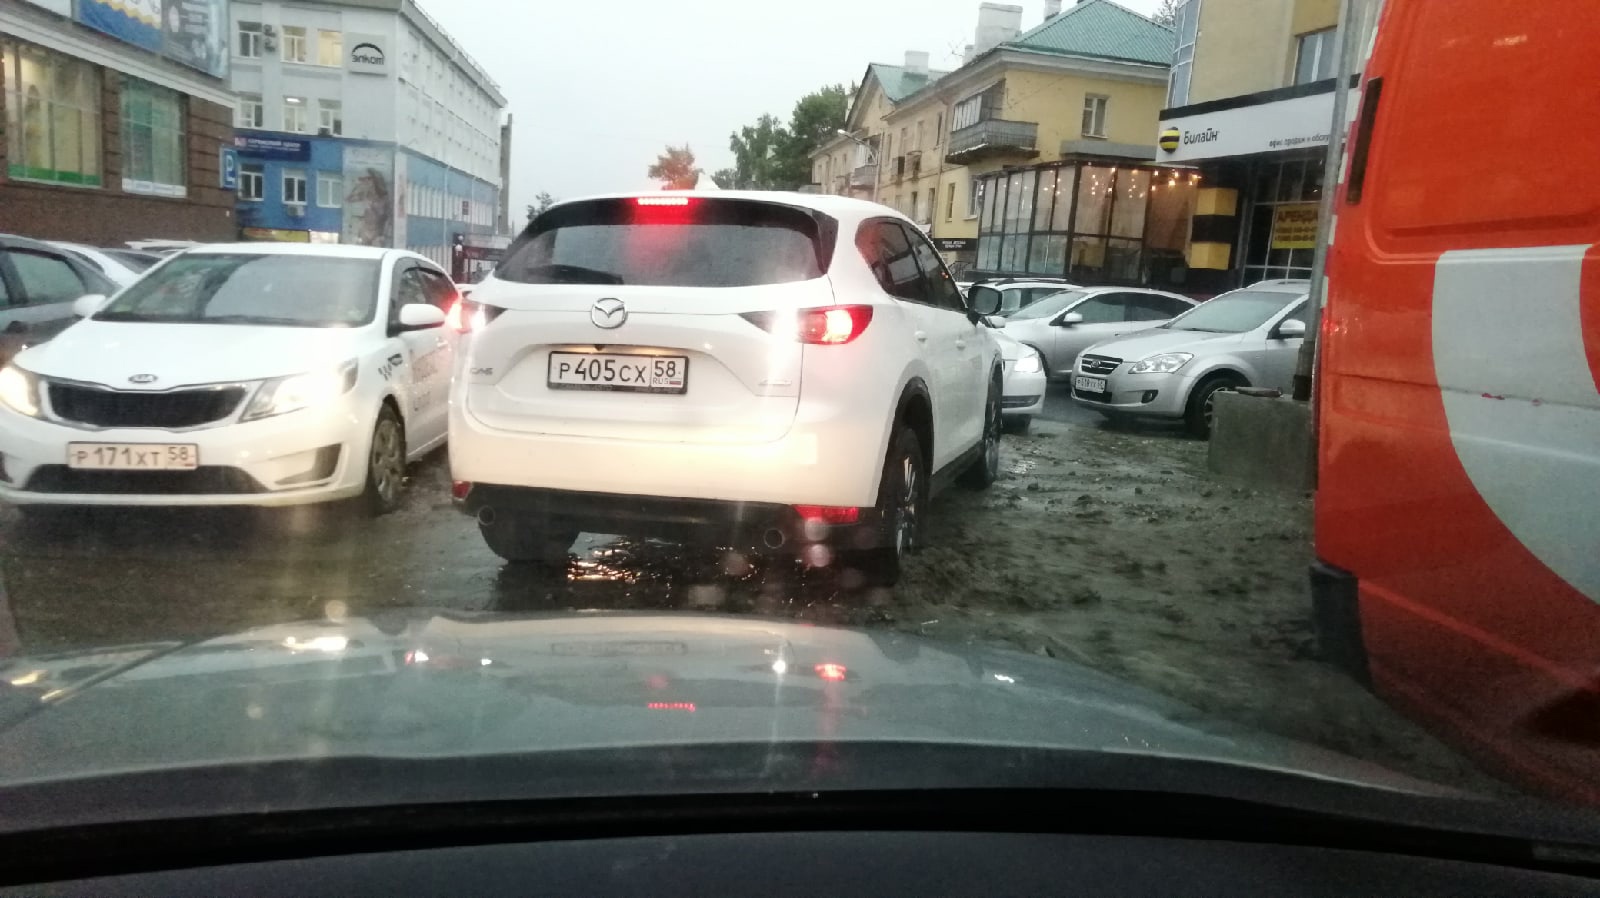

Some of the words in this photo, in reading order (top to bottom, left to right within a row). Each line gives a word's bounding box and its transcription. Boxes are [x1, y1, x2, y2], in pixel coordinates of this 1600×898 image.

[1183, 127, 1219, 145] Билайн
[654, 360, 677, 378] 58
[167, 446, 189, 461] 58
